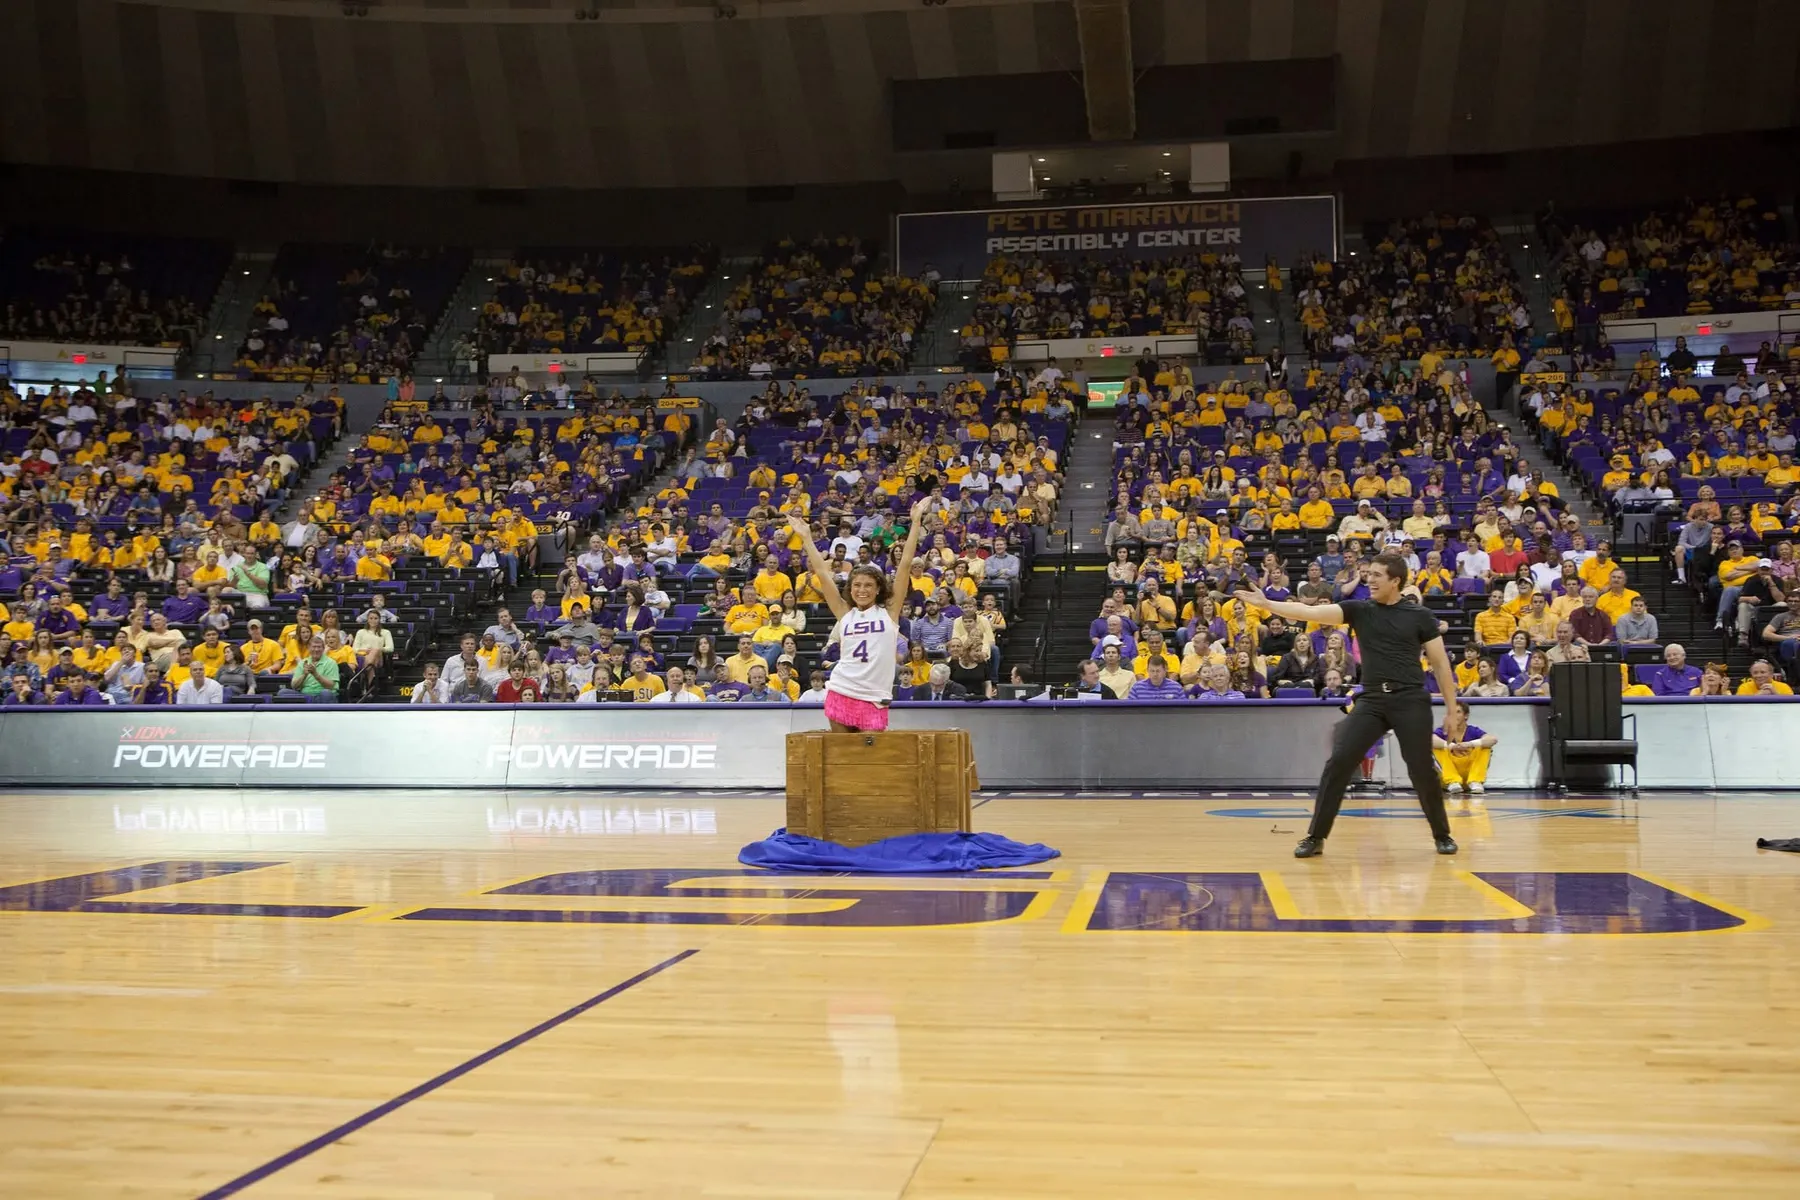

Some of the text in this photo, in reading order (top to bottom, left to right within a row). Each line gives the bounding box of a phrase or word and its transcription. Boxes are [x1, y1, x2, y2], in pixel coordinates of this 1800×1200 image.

[987, 203, 1241, 232] PETE MARAVICH
[986, 228, 1242, 254] ASSEMBLY CENTER
[844, 620, 885, 637] LSU
[852, 639, 869, 663] 4
[53, 676, 68, 685] LS
[113, 744, 328, 768] POWERADE
[486, 744, 718, 769] POWERADE
